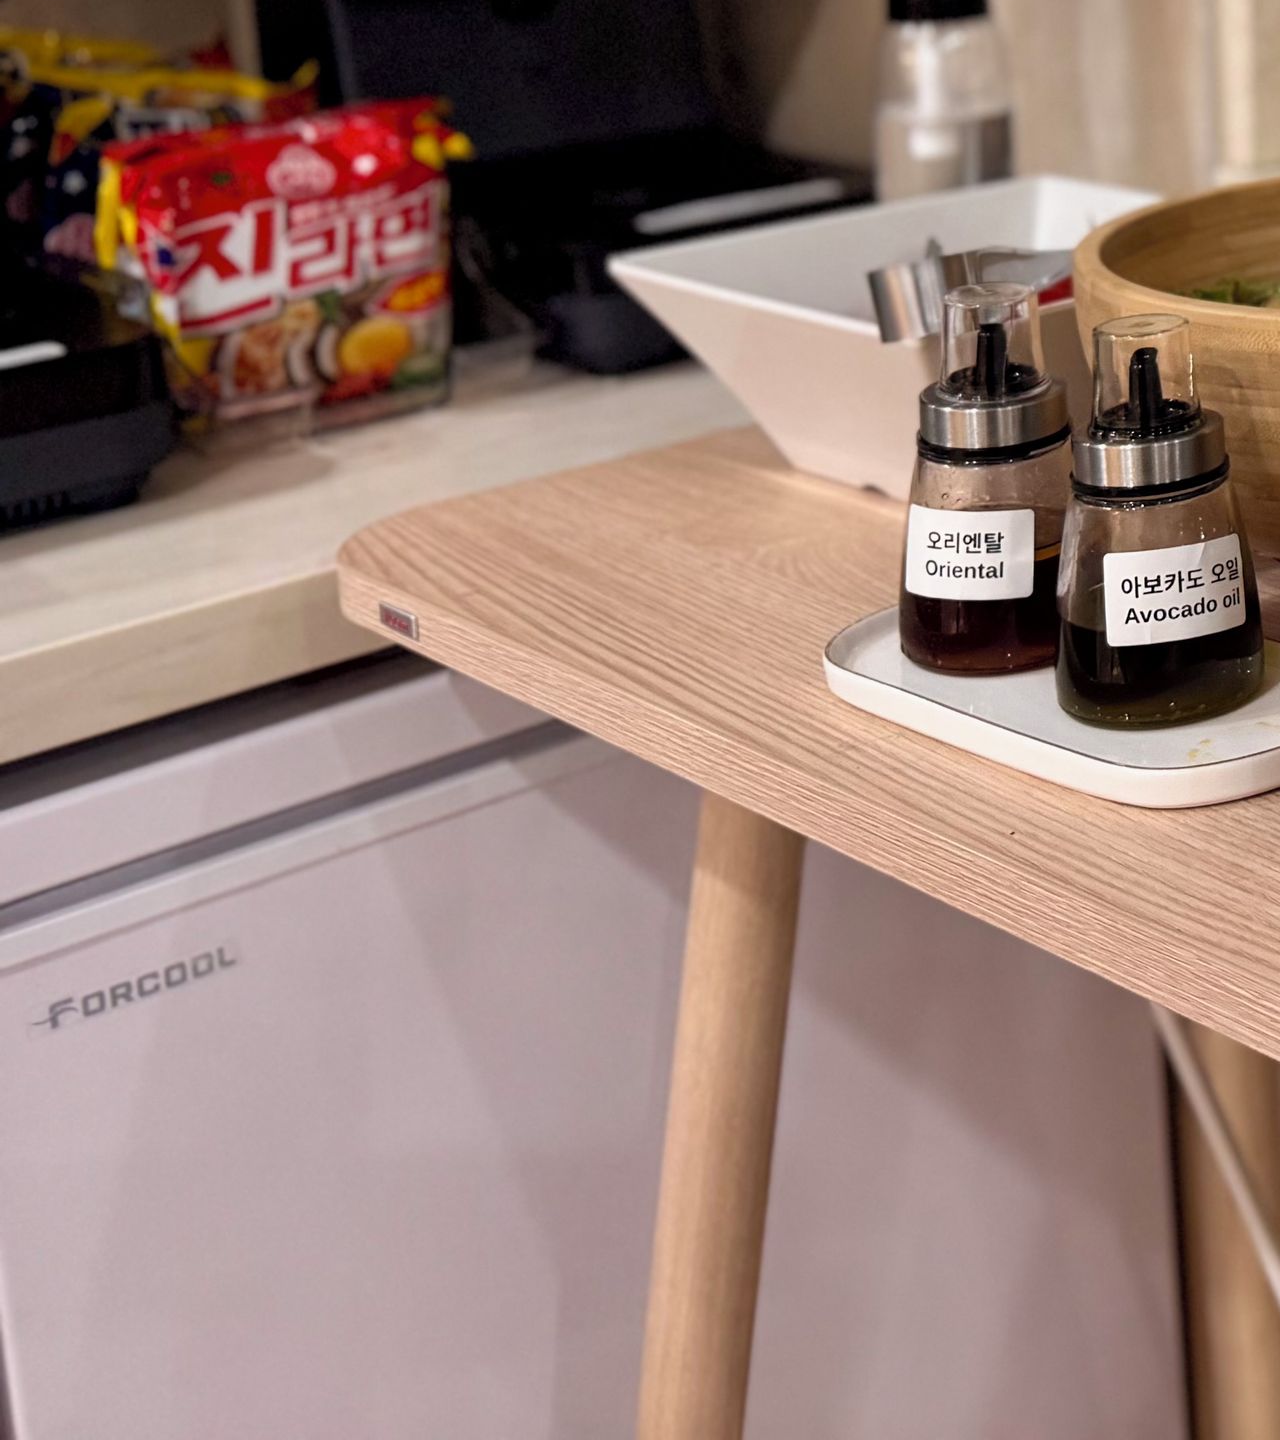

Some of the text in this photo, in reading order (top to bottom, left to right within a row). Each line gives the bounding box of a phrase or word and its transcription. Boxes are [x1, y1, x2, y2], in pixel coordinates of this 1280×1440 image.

[174, 197, 434, 328] 진라면
[927, 531, 1004, 553] 오리엔탈
[926, 560, 1004, 579] Oriental
[1121, 557, 1239, 598] 아보카도 오일
[1125, 587, 1240, 624] Avocado oil
[36, 947, 237, 1029] FORCOOL
